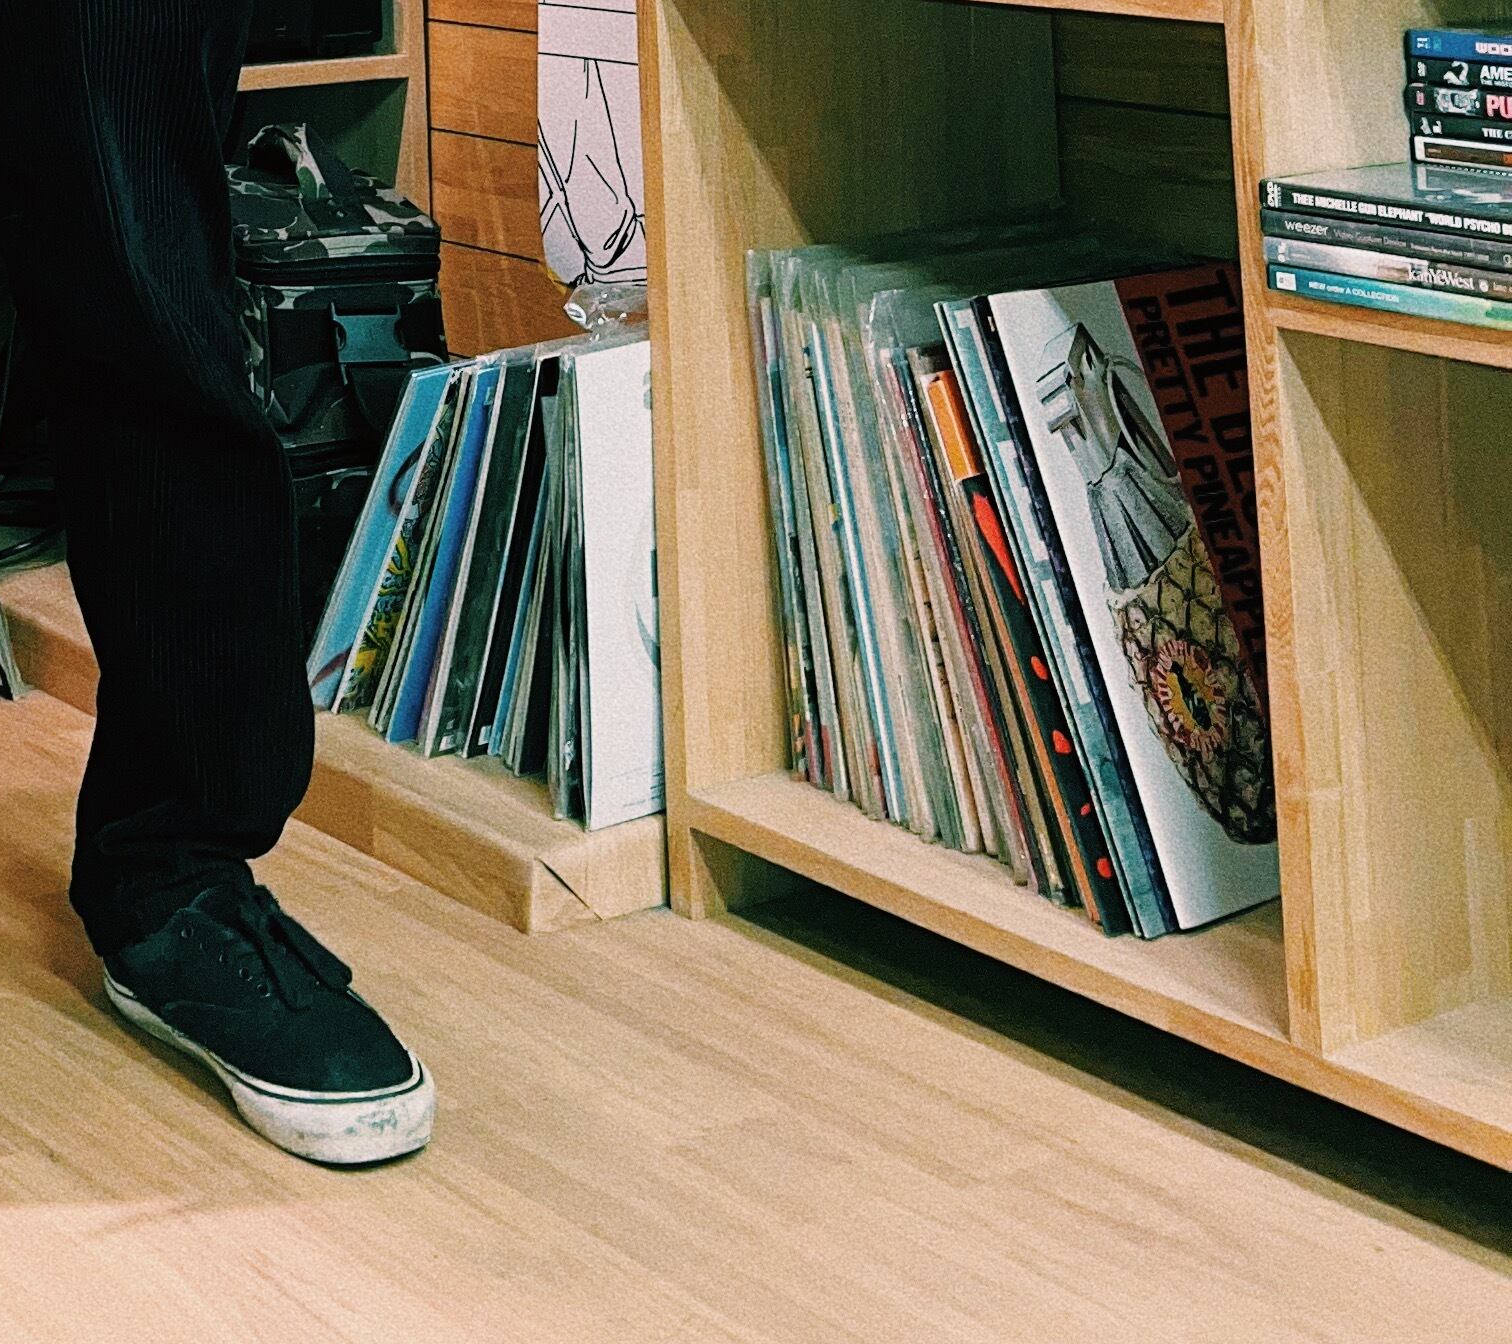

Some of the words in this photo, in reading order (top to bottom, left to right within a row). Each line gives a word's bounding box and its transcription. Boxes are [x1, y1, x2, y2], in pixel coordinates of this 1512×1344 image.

[1284, 219, 1329, 237] weezer
[1291, 192, 1315, 207] THEE
[1314, 196, 1358, 213] MICHELLE
[1377, 204, 1424, 223] ELEPHANT
[1463, 217, 1501, 235] PSYCHO
[1352, 288, 1400, 303] COLLECTION
[1165, 268, 1248, 397] THE
[1126, 296, 1207, 445] PRETTY
